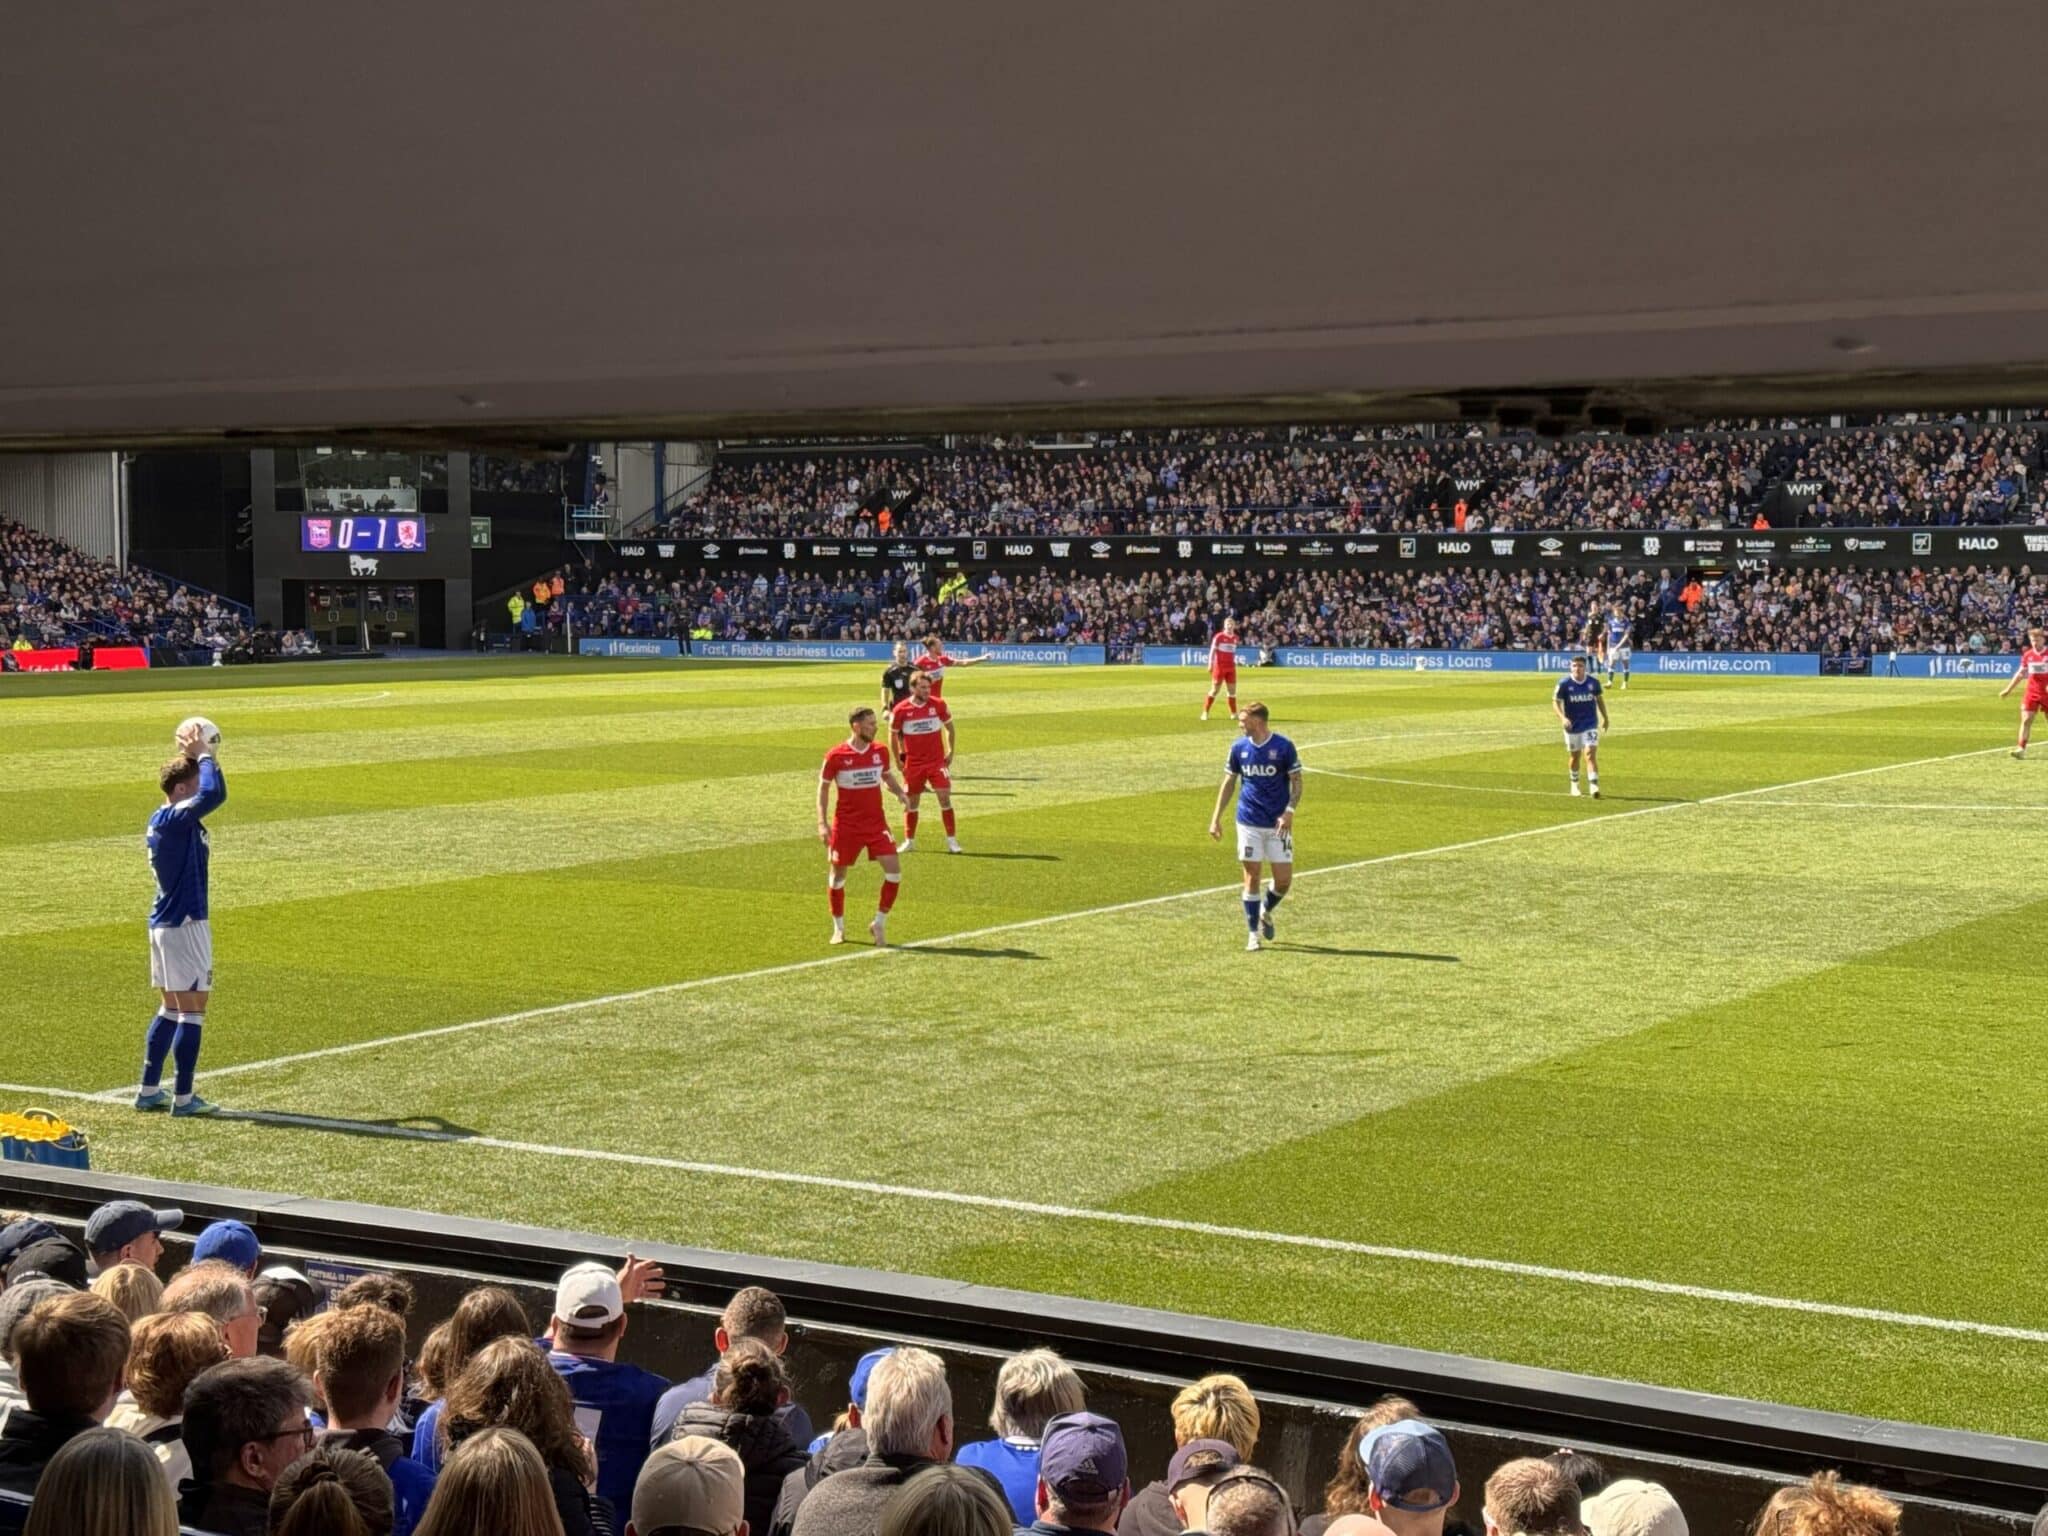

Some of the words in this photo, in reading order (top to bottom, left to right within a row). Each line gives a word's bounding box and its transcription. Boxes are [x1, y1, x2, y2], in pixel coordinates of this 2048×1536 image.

[1438, 542, 1471, 554] HALO
[1958, 538, 1999, 550] HALO
[620, 546, 645, 556] HALO
[1005, 545, 1034, 556] HALO
[619, 643, 661, 653] fleximize
[702, 644, 728, 656] Fast,
[731, 644, 773, 656] Flexible
[775, 645, 826, 657] Business
[830, 646, 865, 657] Loans
[1287, 653, 1319, 666] Fast,
[1323, 653, 1375, 666] Flexible
[1448, 655, 1492, 668] Loans
[1659, 655, 1771, 671] fleximize.com
[1241, 764, 1277, 777] HALO
